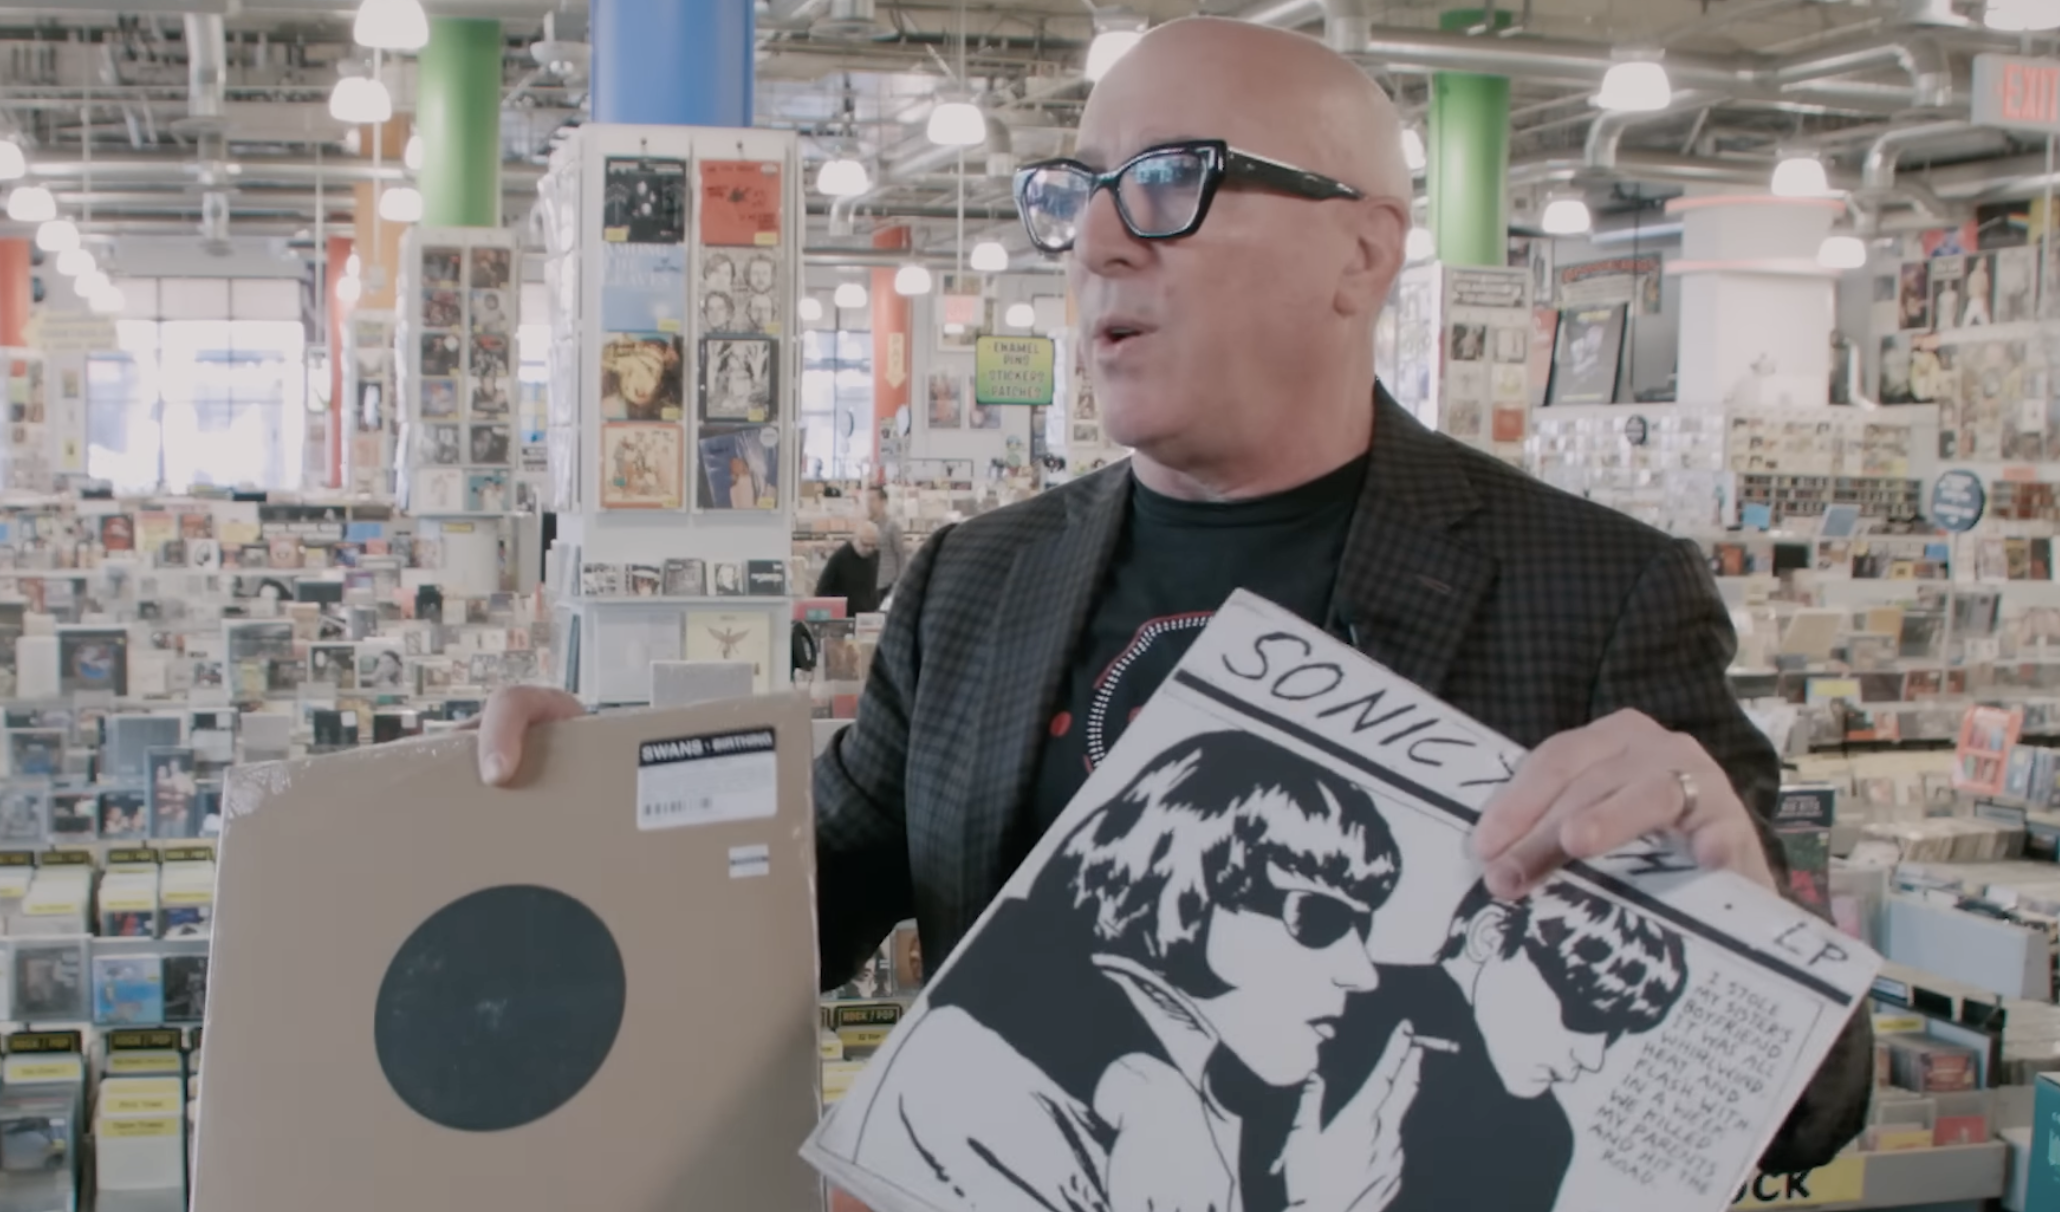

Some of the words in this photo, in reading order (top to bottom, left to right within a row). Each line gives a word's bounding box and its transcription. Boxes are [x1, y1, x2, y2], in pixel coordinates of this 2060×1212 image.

[2002, 63, 2060, 124] EXIT
[993, 341, 1040, 354] ENAMEL
[1003, 354, 1030, 366] PINS
[988, 370, 1045, 383] STICKERS
[991, 386, 1042, 398] PATCHES
[1222, 631, 1477, 768] SONIC
[641, 738, 704, 763] SWANS
[1773, 920, 1850, 967] LP
[1696, 1073, 1740, 1103] AND
